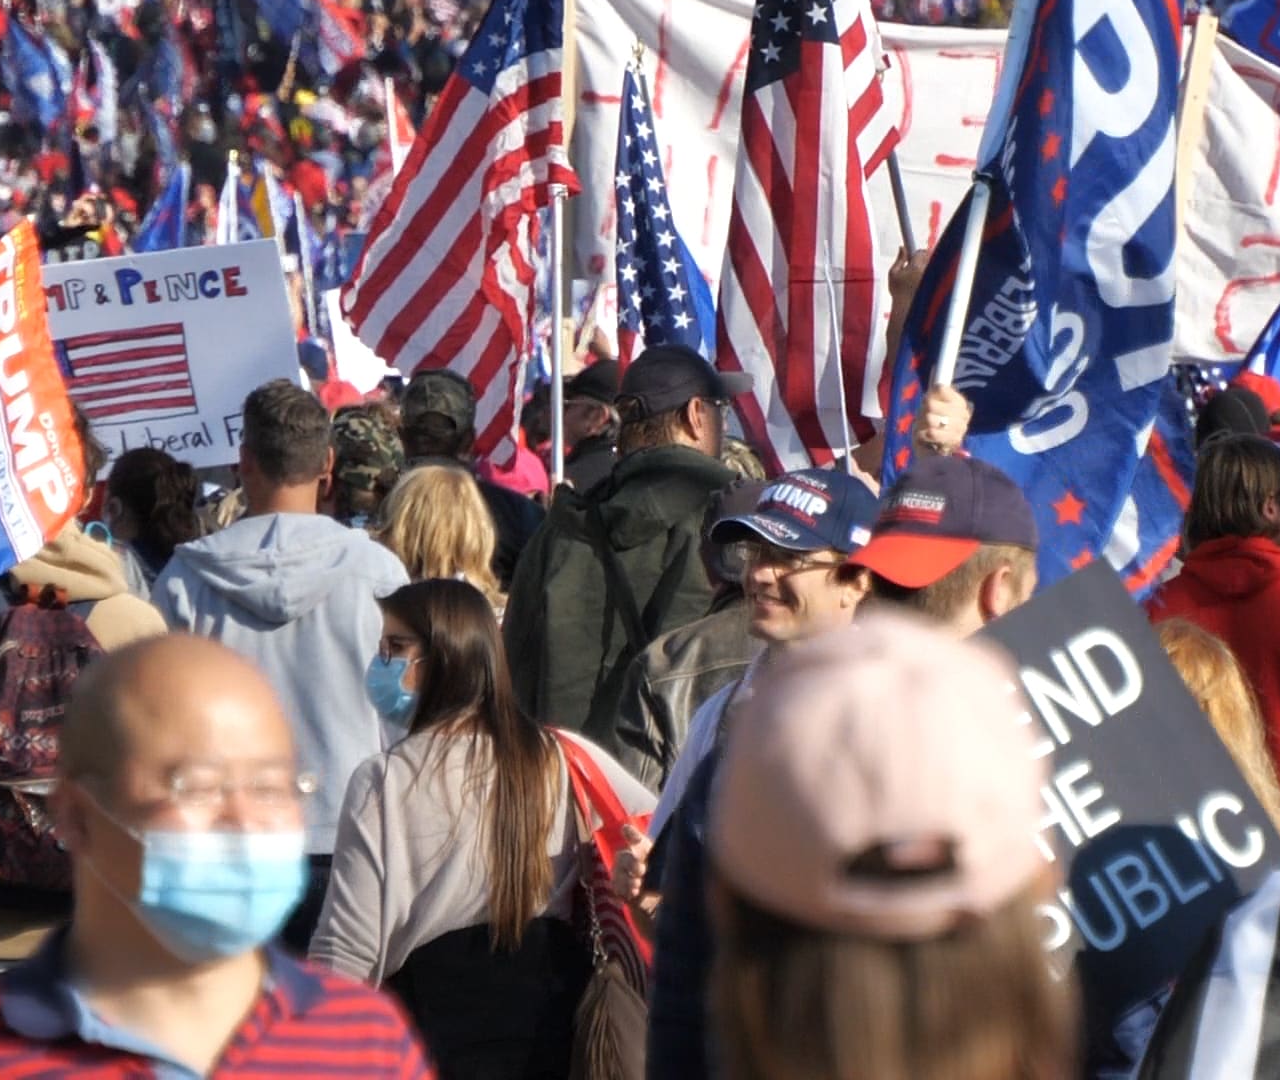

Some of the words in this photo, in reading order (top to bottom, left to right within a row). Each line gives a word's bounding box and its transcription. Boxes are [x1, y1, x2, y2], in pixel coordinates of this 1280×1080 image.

[94, 282, 111, 307] &
[114, 265, 249, 307] PENCE
[121, 422, 214, 458] Liberal
[1033, 759, 1122, 862] HE
